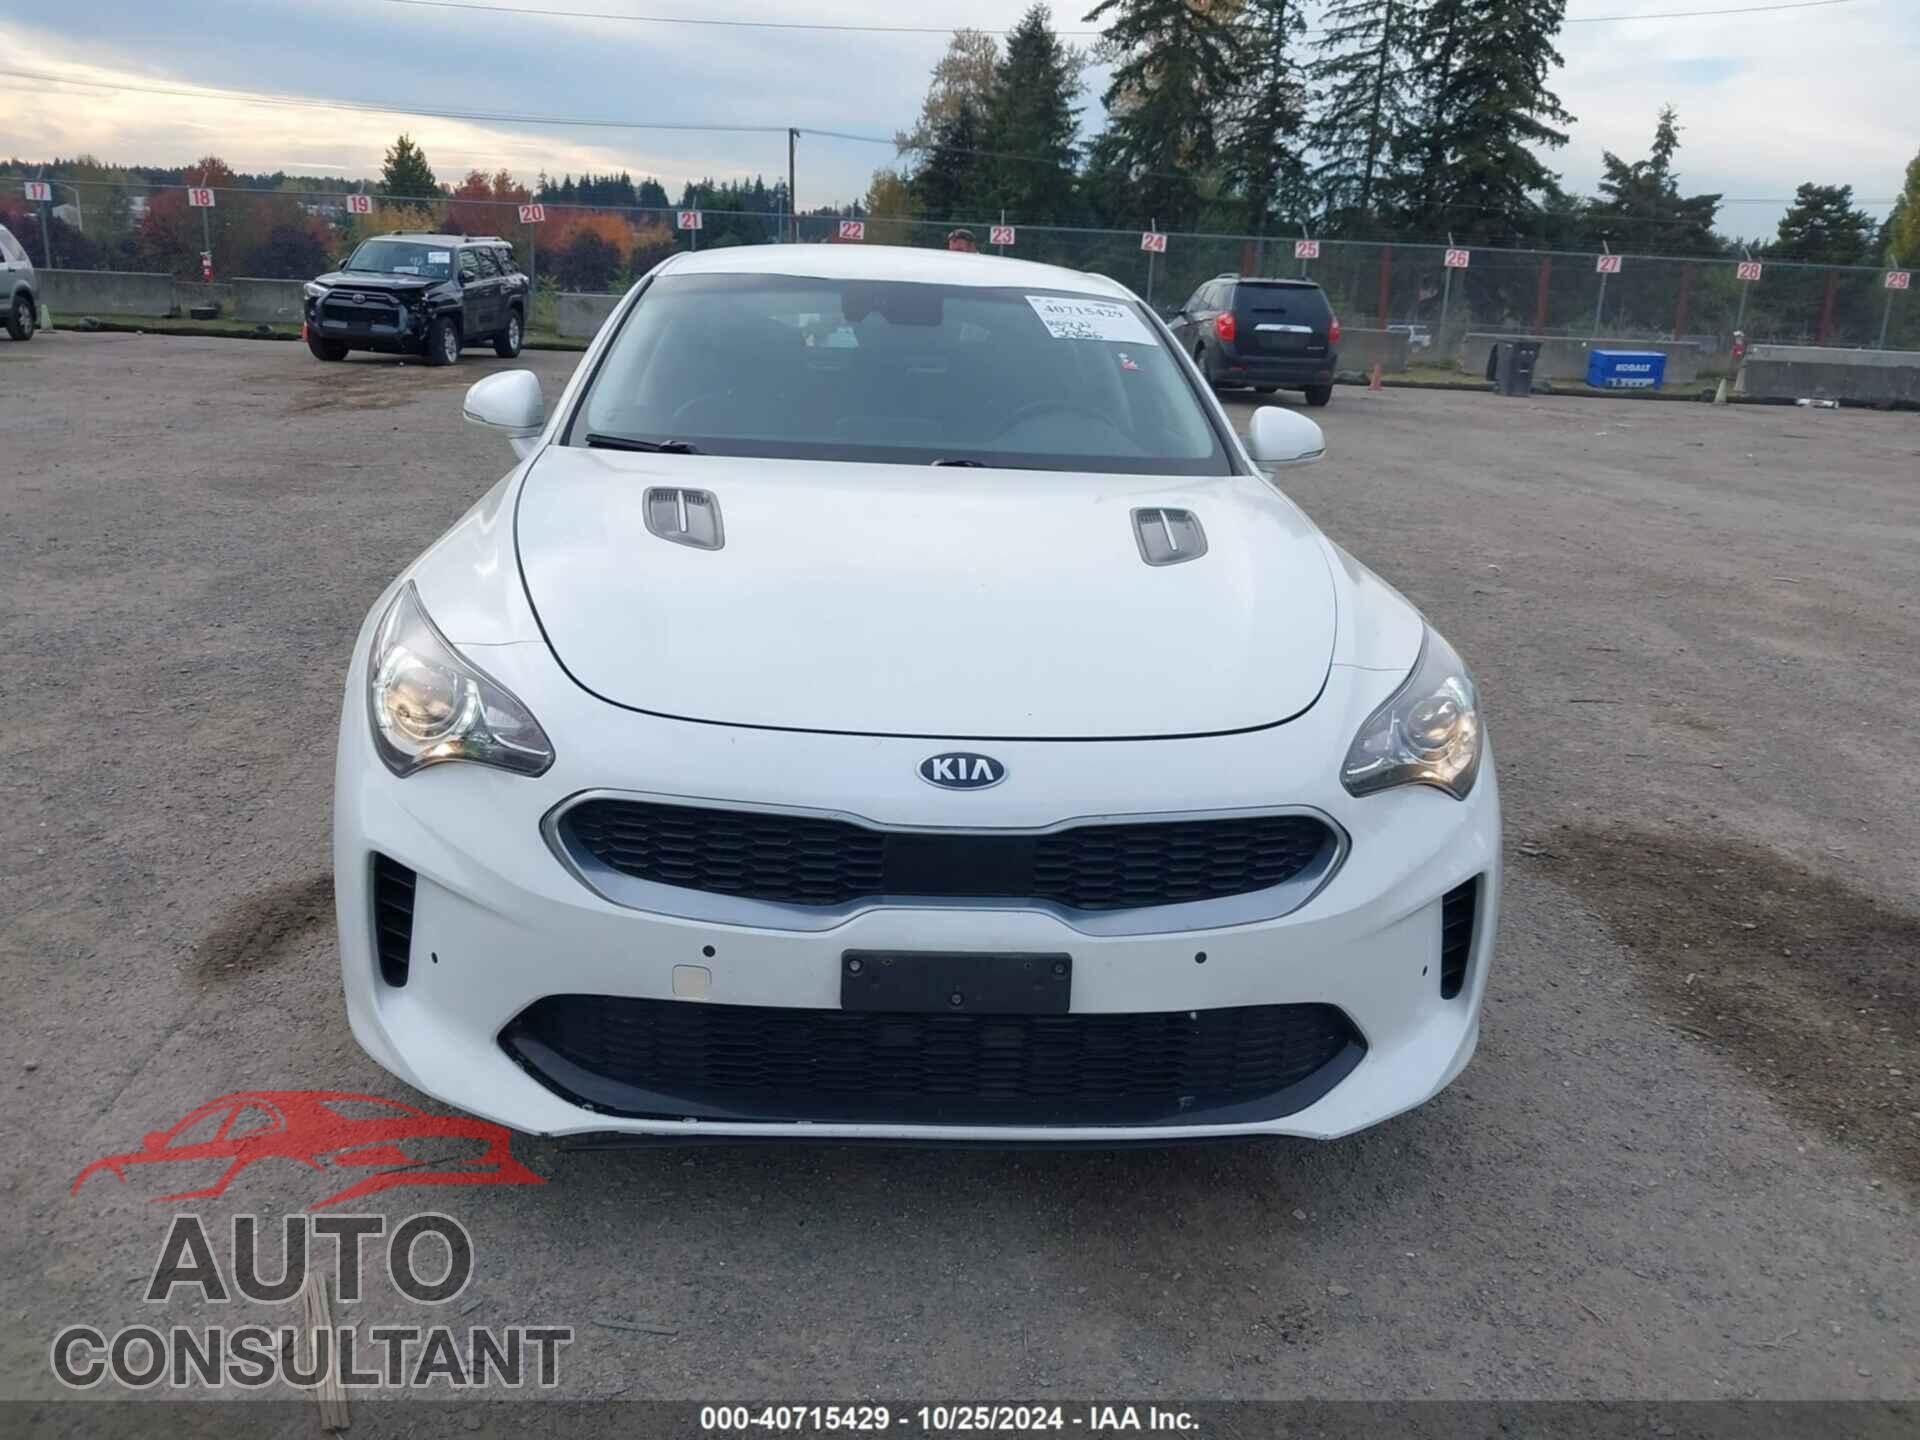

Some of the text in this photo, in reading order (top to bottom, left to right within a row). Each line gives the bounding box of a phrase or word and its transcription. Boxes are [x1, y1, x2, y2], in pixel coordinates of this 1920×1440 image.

[31, 183, 45, 198] 17
[193, 189, 209, 206] 18
[351, 196, 368, 212] 19
[521, 205, 542, 222] 20
[681, 212, 698, 228] 21
[842, 222, 862, 239] 22
[993, 227, 1012, 243] 23
[1144, 234, 1163, 251] 24
[1298, 241, 1316, 257] 25
[1448, 250, 1465, 266] 26
[1600, 257, 1617, 272] 27
[1741, 263, 1758, 279] 28
[1888, 272, 1907, 288] 29
[932, 758, 995, 780] KIA
